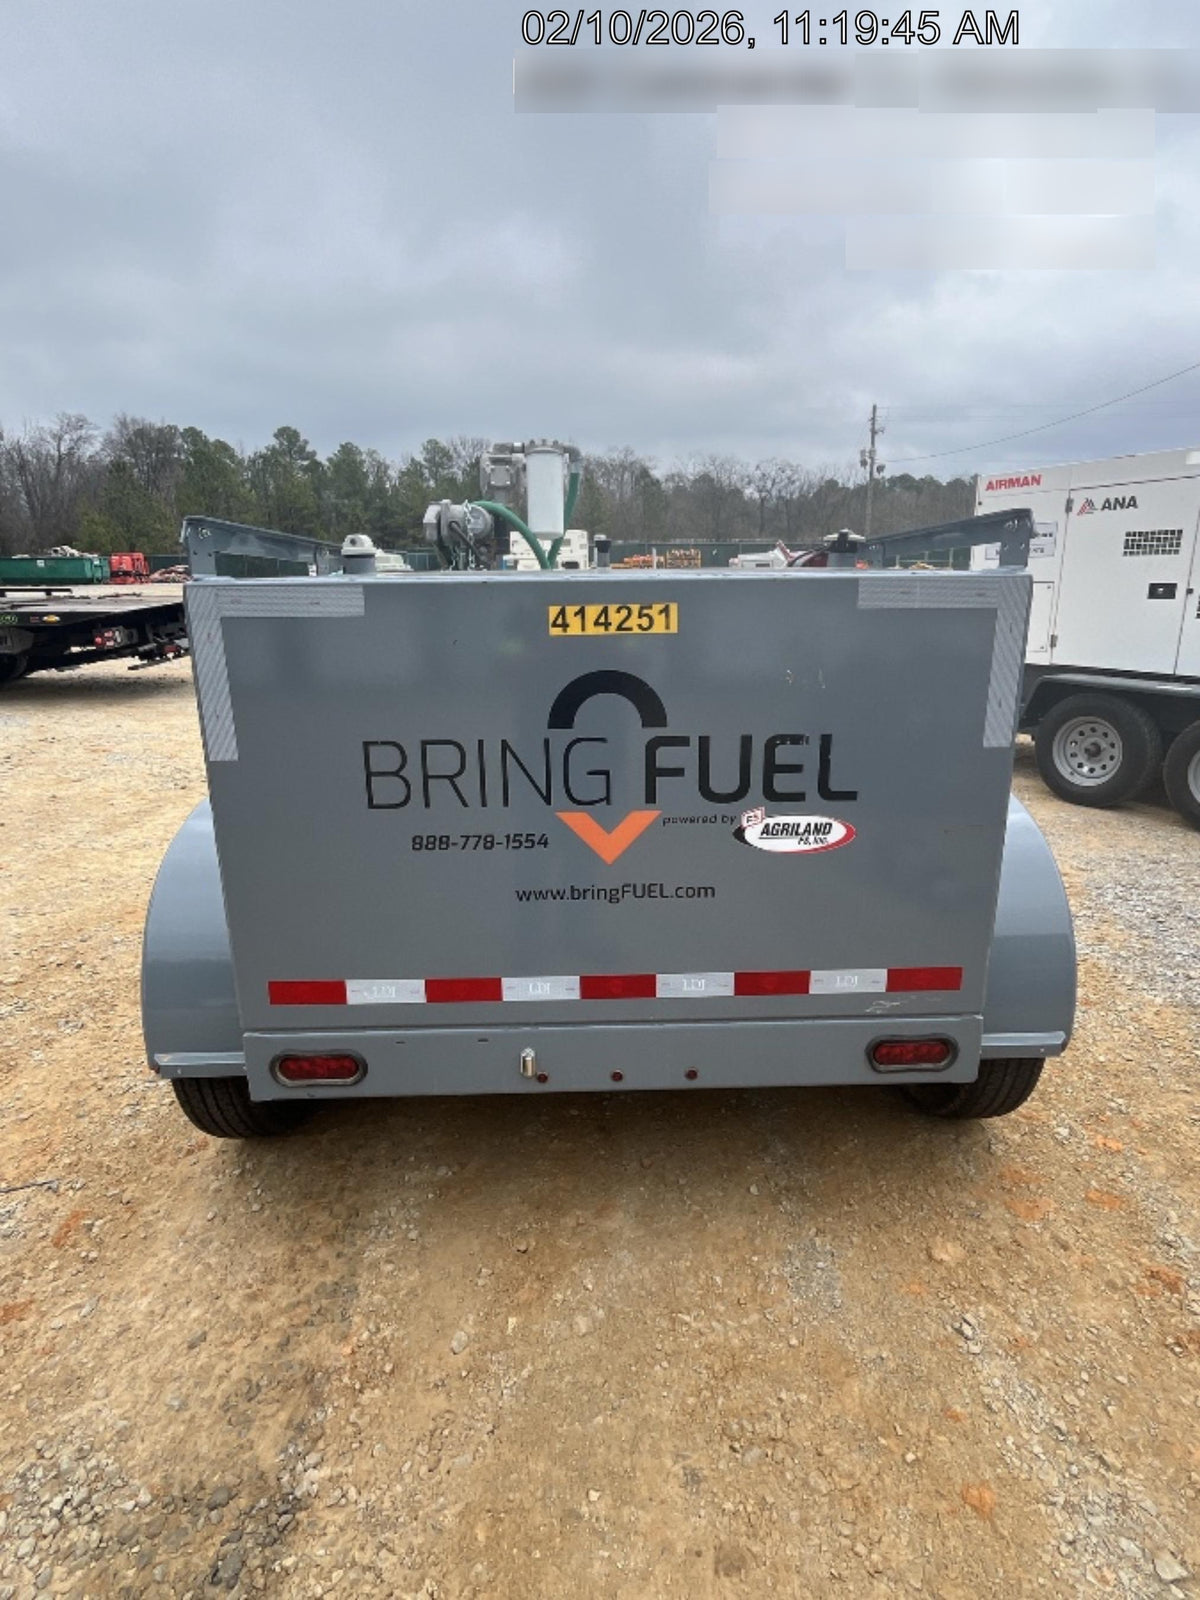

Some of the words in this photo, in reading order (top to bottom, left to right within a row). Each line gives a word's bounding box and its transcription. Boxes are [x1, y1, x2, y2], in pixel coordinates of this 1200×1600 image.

[985, 474, 1042, 491] AIRMAN
[1101, 496, 1138, 511] ANA
[551, 604, 671, 633] 414251
[362, 737, 613, 809] BRING
[644, 734, 858, 804] FUEL
[663, 814, 718, 826] powered
[721, 814, 736, 824] by
[760, 822, 833, 836] AGRILAND
[411, 833, 550, 851] 888-778-1554
[515, 882, 716, 904] www.bringFUEL.com
